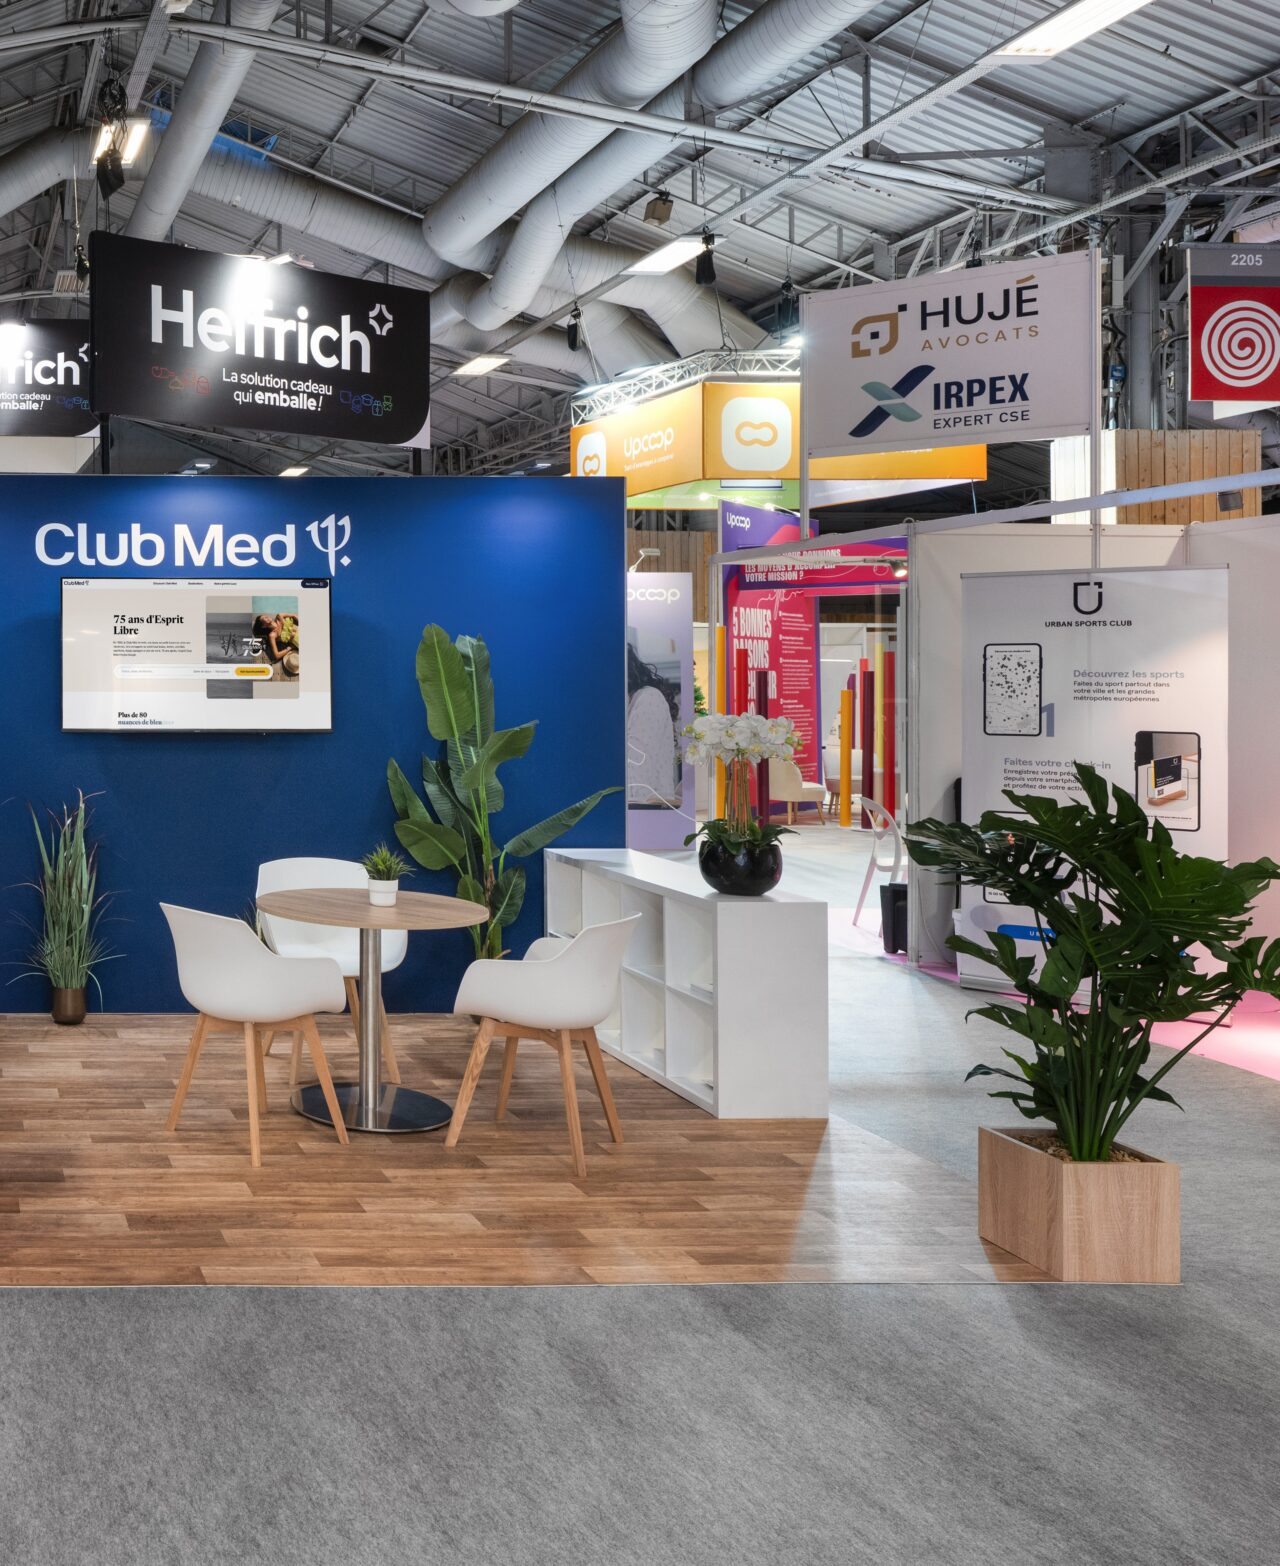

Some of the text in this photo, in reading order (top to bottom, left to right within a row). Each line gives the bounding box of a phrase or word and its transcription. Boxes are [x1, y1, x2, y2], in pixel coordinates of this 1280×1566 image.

[1231, 254, 1263, 266] 2205
[920, 274, 1039, 331] HUJÉ
[921, 325, 1039, 351] AVOCATS
[222, 368, 333, 395] La solution cadeau
[20, 391, 51, 401] cadeau
[233, 389, 253, 405] qui
[933, 372, 1030, 411] IRPEX
[933, 409, 1030, 430] EXPERT CSE
[35, 522, 296, 567] Club Med
[745, 573, 767, 582] VOTRE
[768, 571, 798, 581] MISSION
[113, 614, 184, 626] 75 ans d'Esprit
[732, 607, 738, 636] 5
[739, 607, 772, 638] BONNES
[113, 625, 139, 635] Libre
[1073, 669, 1185, 680] Découvrez les sports
[1125, 681, 1152, 689] partout
[1127, 688, 1156, 696] grandes
[1113, 695, 1160, 703] européennes
[1041, 702, 1055, 737] 1
[1004, 757, 1033, 766] Faites
[1035, 759, 1061, 767] votre
[1003, 768, 1039, 777] Enregistrez
[1003, 775, 1025, 783] depuis
